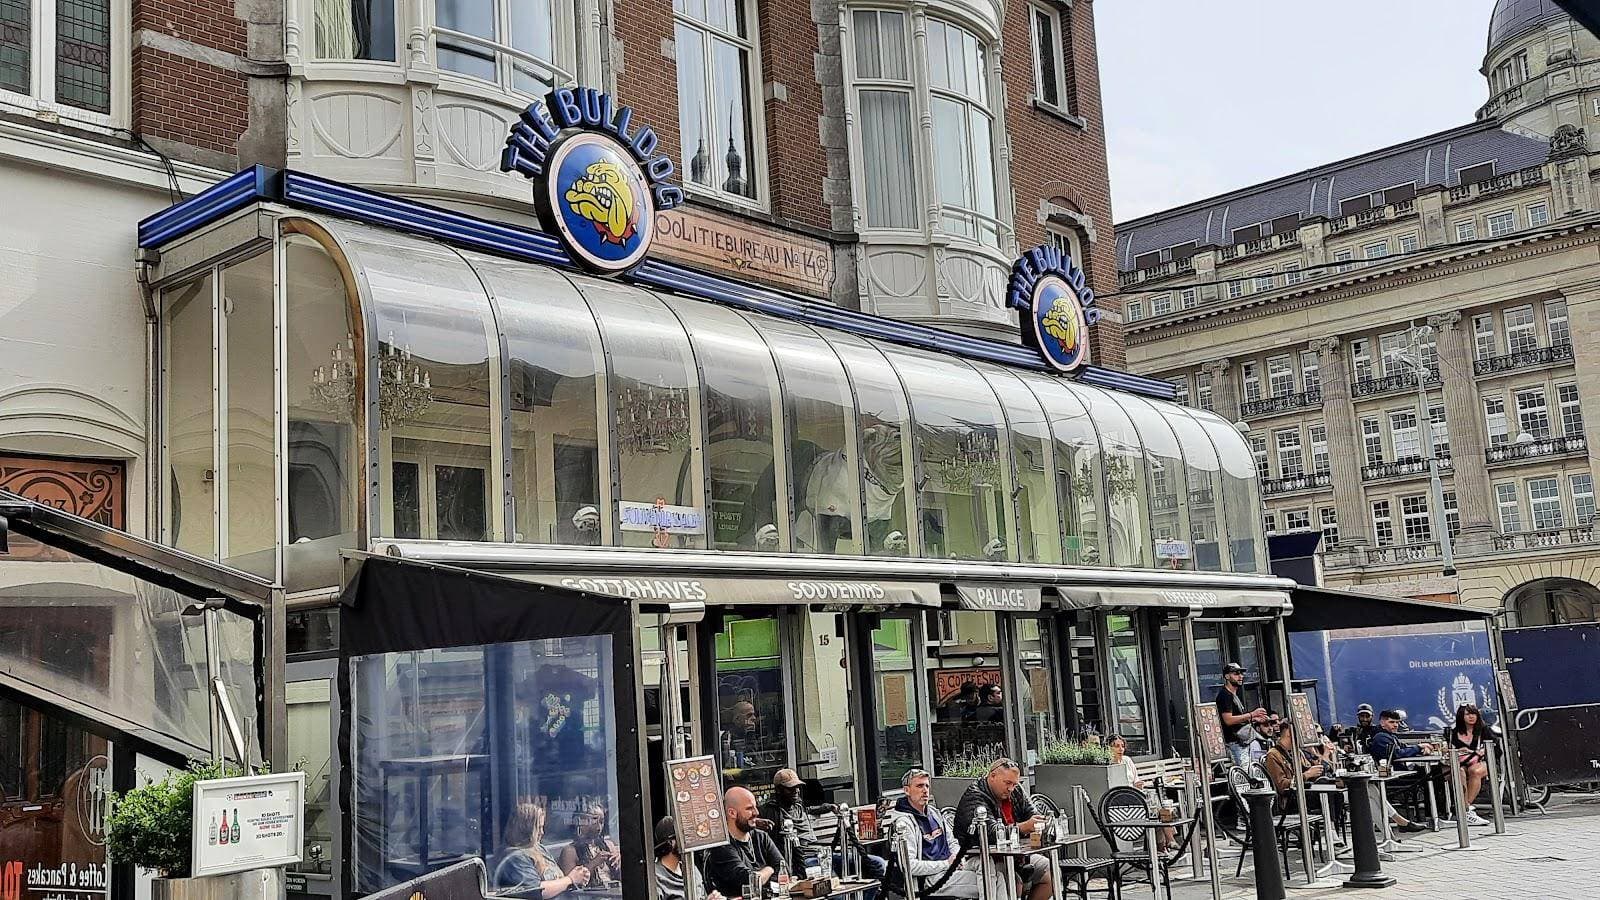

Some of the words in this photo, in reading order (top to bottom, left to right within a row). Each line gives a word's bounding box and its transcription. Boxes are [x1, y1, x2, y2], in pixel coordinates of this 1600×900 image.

[502, 100, 561, 178] THE
[547, 87, 684, 210] BULLDOG
[655, 214, 779, 264] POLITIEBUREAU
[1006, 256, 1039, 310] THE
[1029, 244, 1101, 326] BULLDOG
[787, 582, 885, 600] SOUVENIRS
[977, 588, 1025, 607] PALACE
[819, 634, 830, 646] 15
[1409, 660, 1421, 668] Dit
[1421, 660, 1428, 668] is
[1444, 657, 1492, 667] ontwikkelin
[1456, 692, 1467, 701] M
